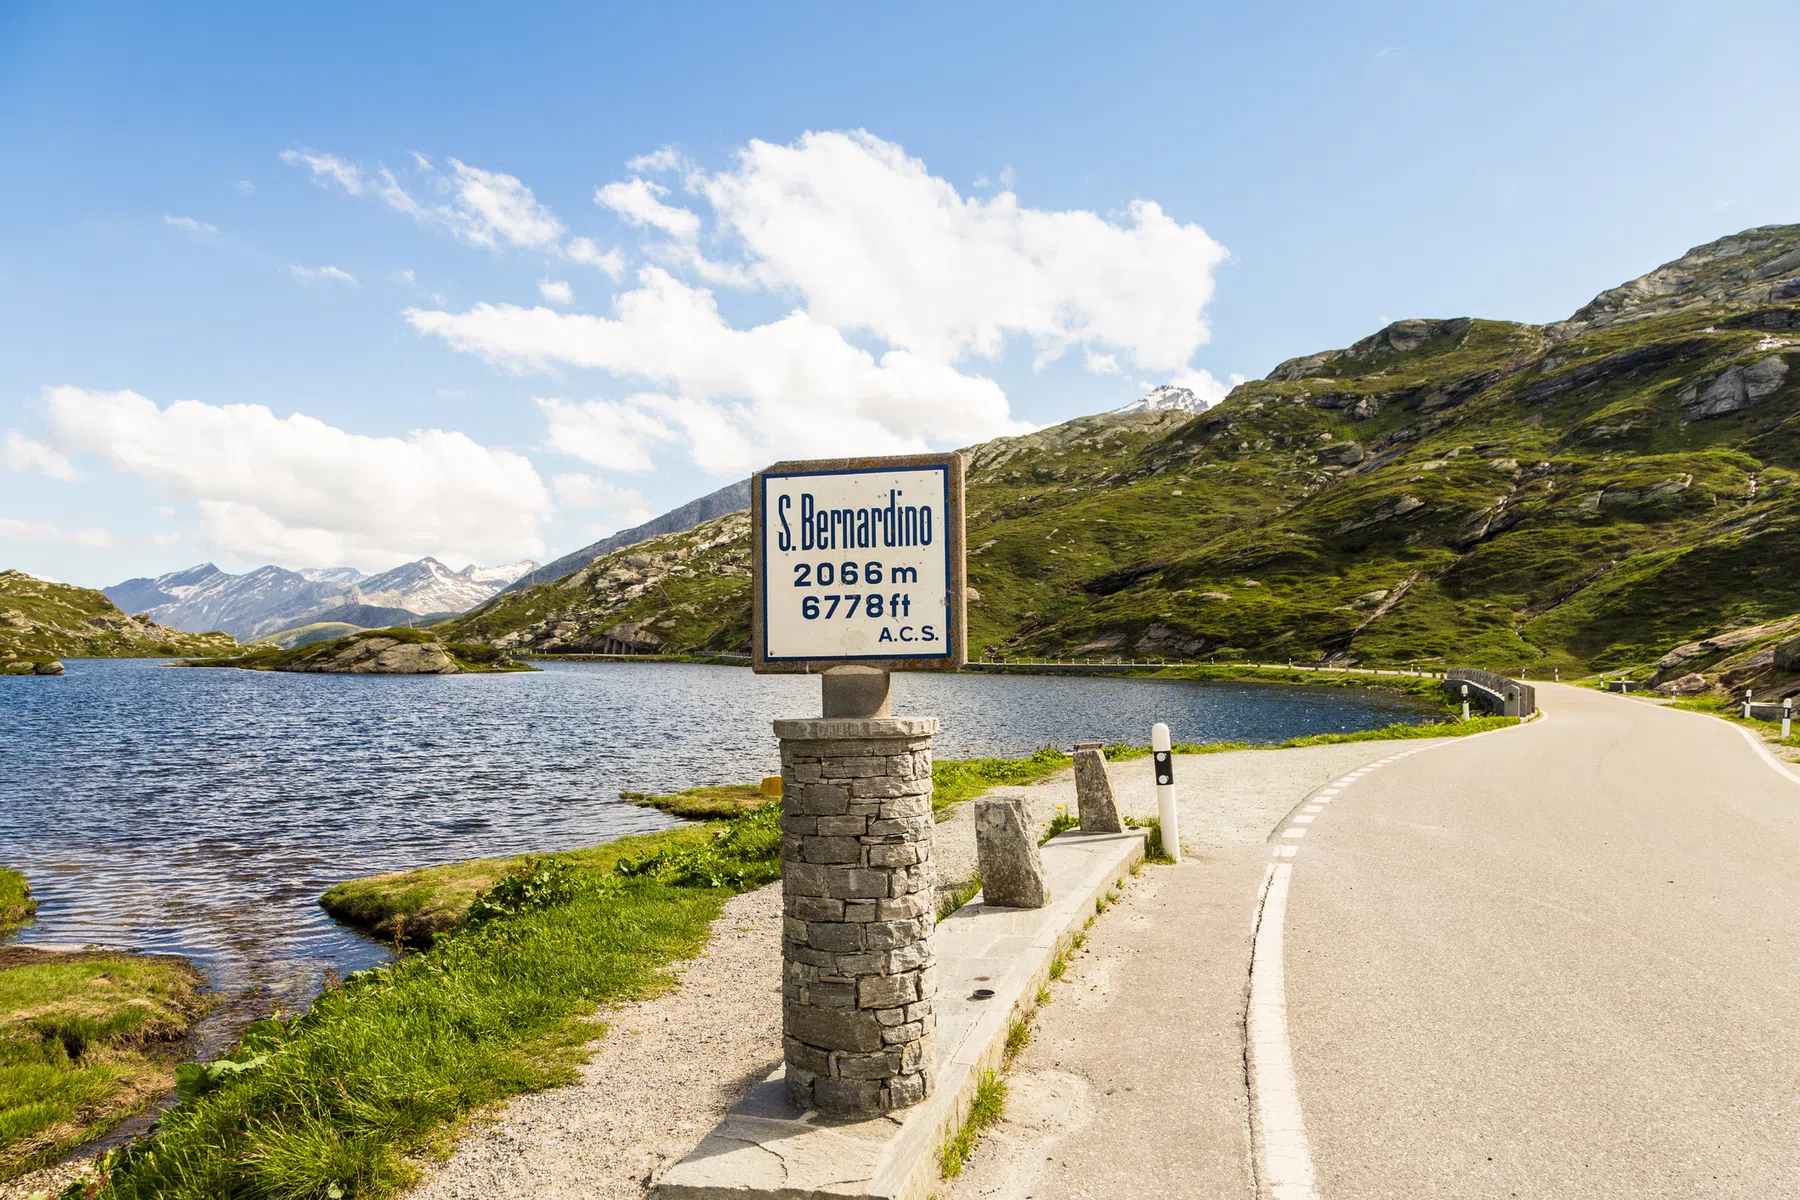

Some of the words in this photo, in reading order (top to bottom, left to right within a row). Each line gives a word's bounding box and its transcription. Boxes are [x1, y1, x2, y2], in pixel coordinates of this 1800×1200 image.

[793, 561, 883, 587] 2066
[891, 566, 917, 584] m
[802, 593, 884, 620] 6778
[889, 593, 911, 617] ft
[878, 625, 939, 643] A.C.S.
